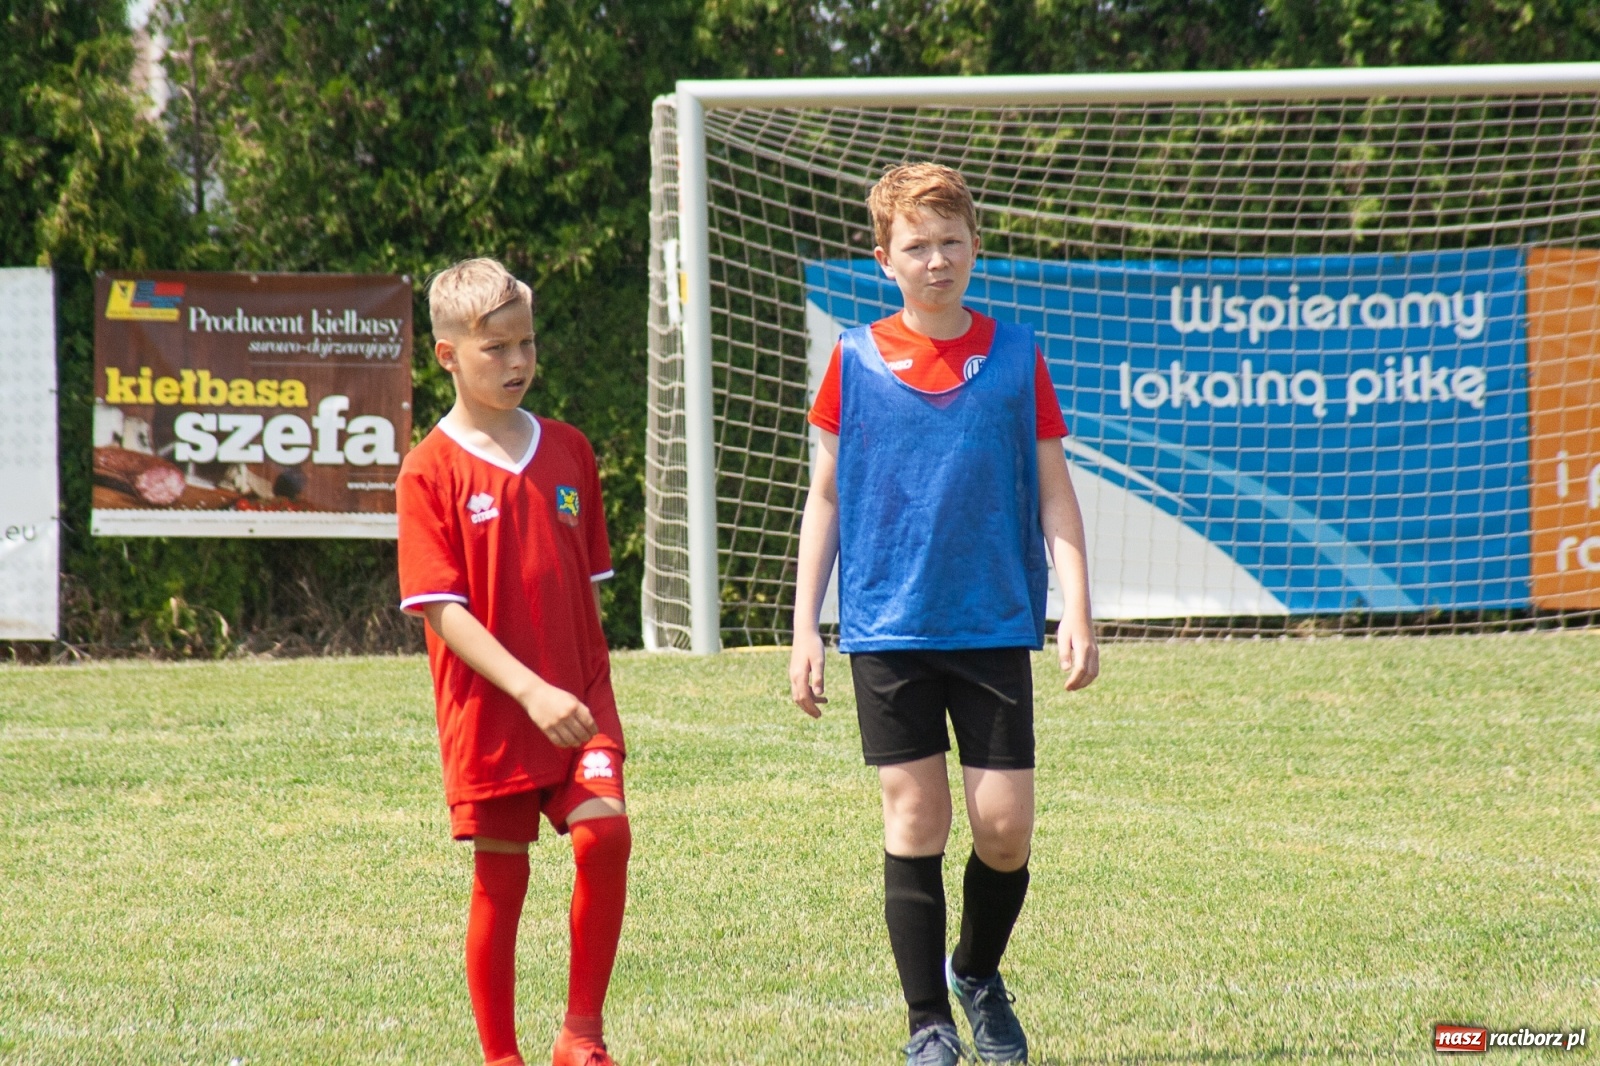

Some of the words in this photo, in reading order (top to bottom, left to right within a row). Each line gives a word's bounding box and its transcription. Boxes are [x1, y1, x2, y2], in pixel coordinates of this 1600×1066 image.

[189, 306, 304, 334] Producent
[1170, 283, 1486, 344] Wspieramy
[105, 366, 309, 408] kiełbasa
[1119, 359, 1327, 418] lokalną
[1346, 355, 1487, 417] piłkę
[174, 395, 400, 466] szefa
[1556, 450, 1569, 498] i
